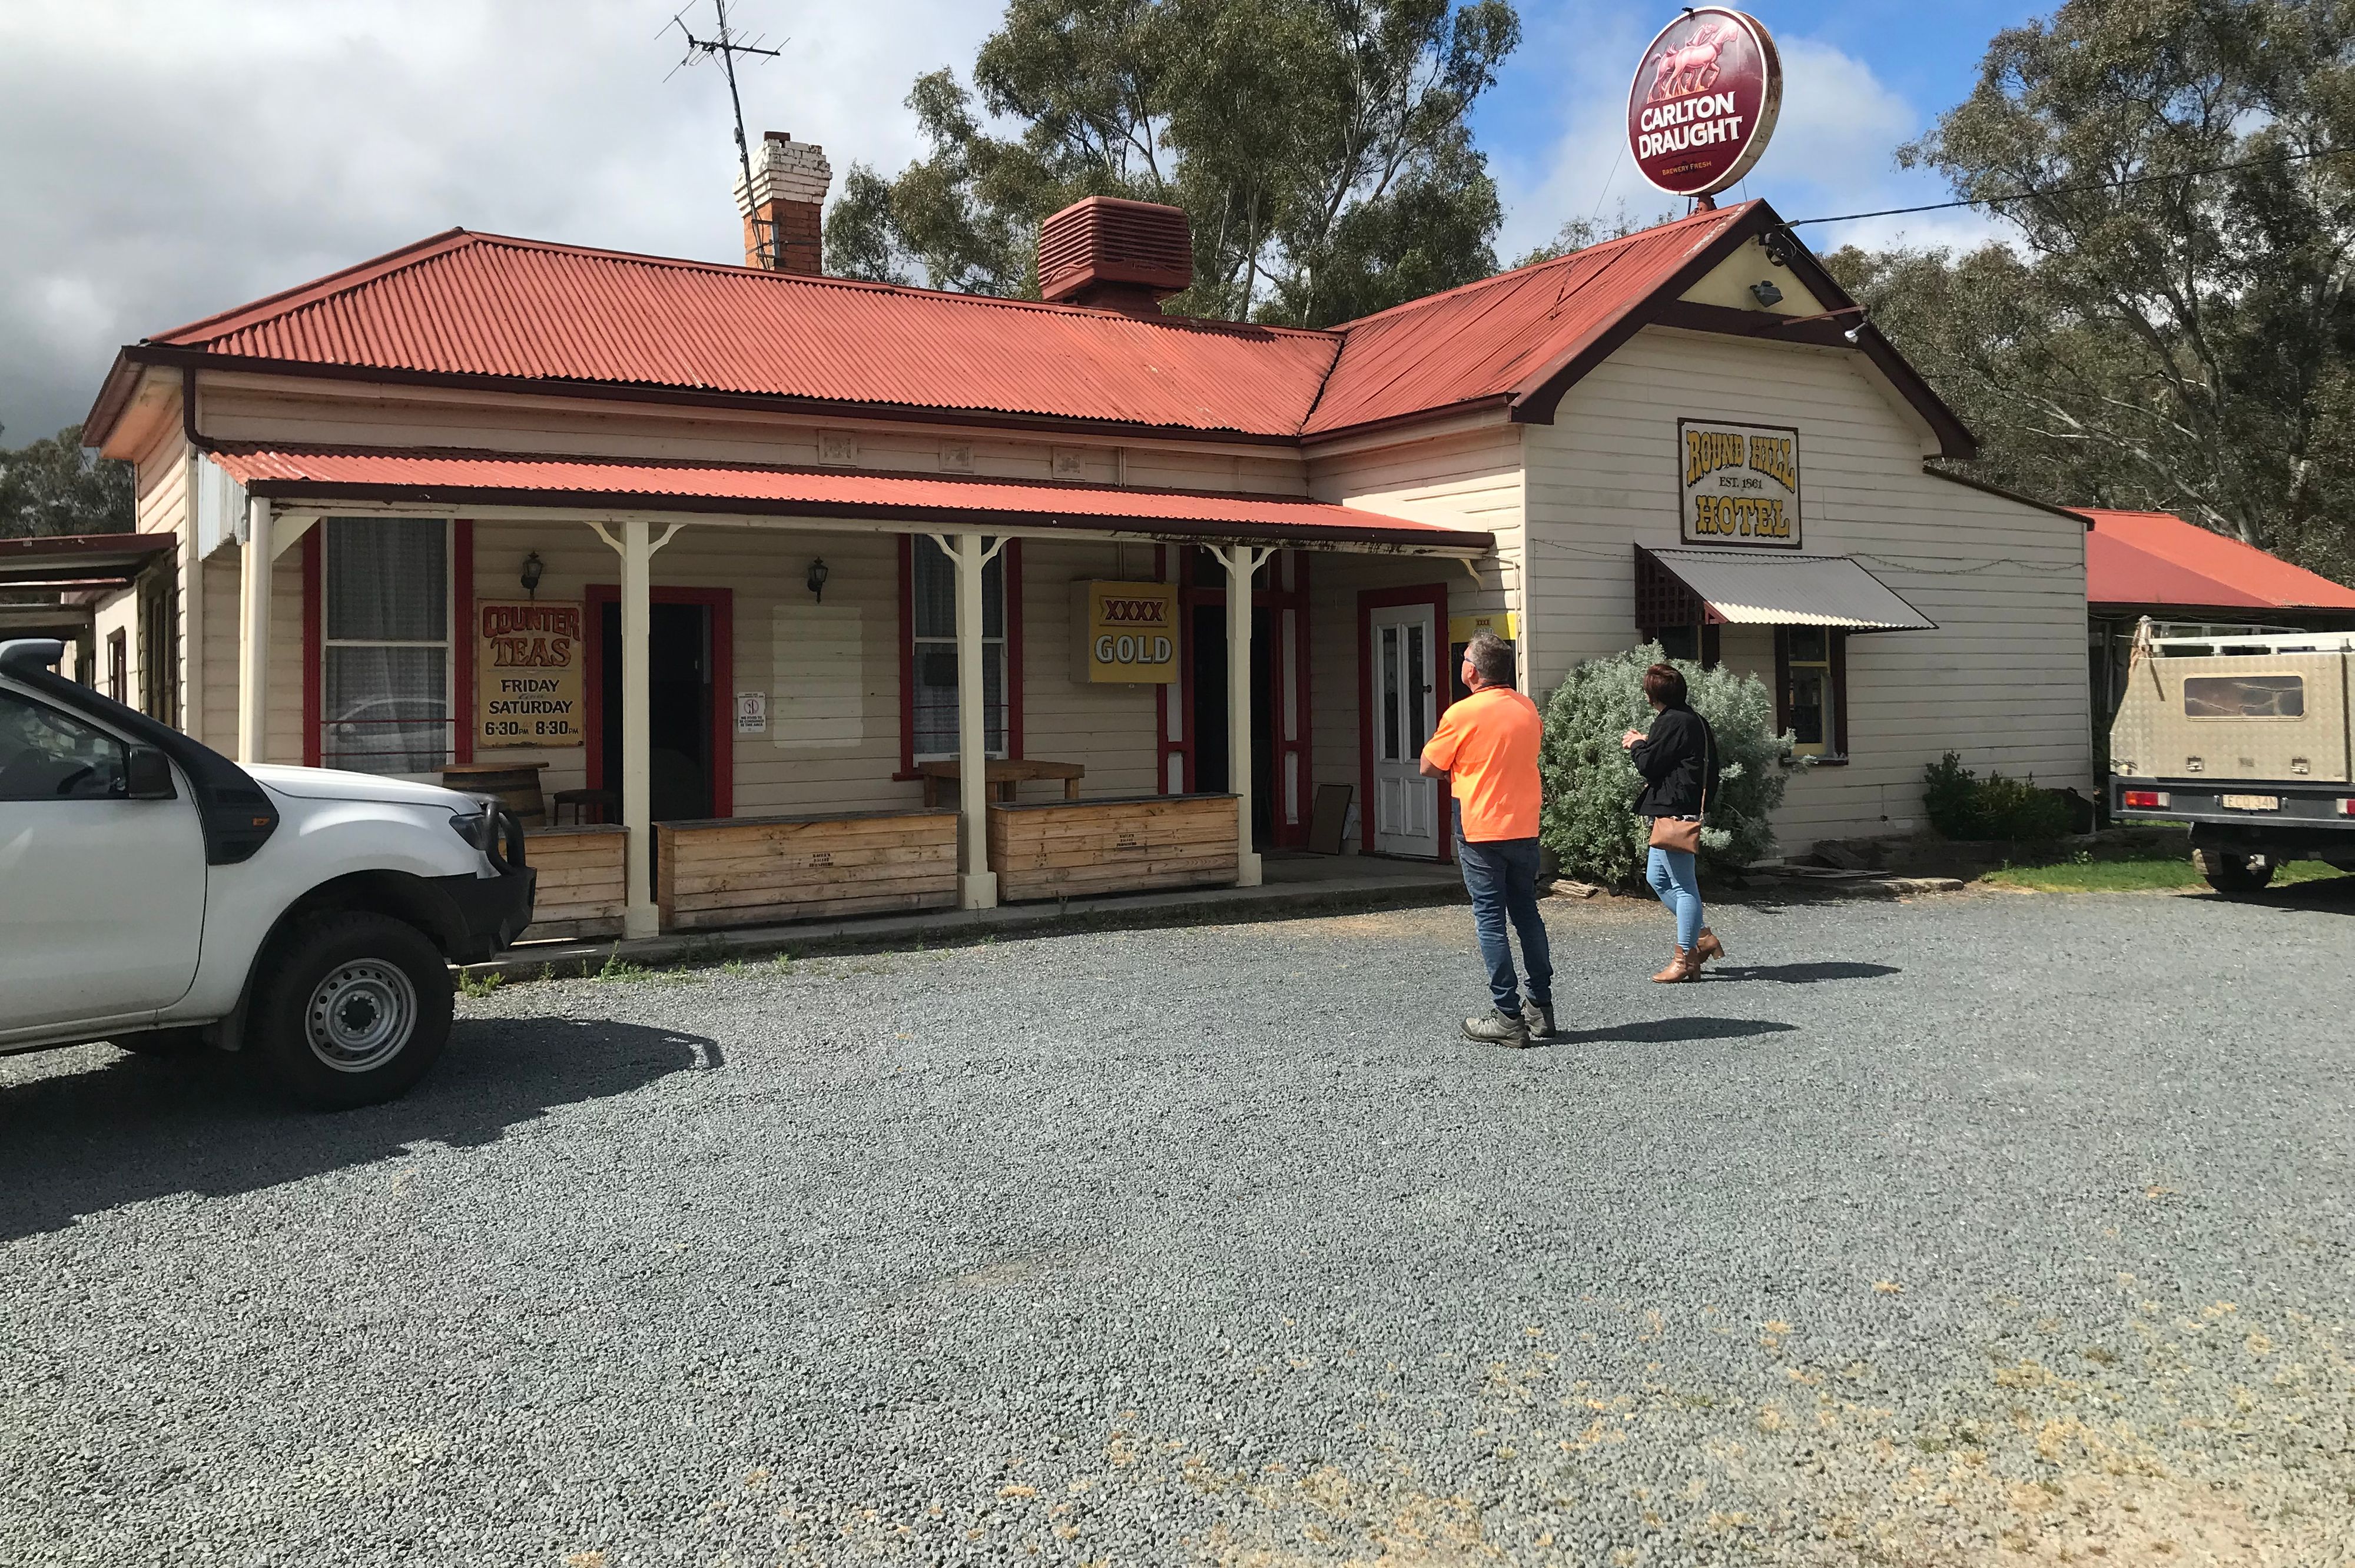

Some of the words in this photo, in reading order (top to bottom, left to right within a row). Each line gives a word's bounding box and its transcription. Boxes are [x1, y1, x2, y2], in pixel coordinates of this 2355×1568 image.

[1641, 91, 1736, 132] CARLTON
[1638, 116, 1743, 160] DRAUGHT
[1662, 165, 1689, 175] BREWERY
[1690, 161, 1711, 170] FRESH
[1686, 430, 1744, 488] ROUND
[1749, 436, 1796, 493] HILL
[1719, 477, 1739, 487] EST.
[1742, 479, 1763, 489] 1861
[1696, 495, 1790, 538] HOTEL
[483, 606, 581, 642] COUNTER
[1105, 600, 1163, 621] XXXX
[490, 637, 572, 667] TEAS
[1094, 634, 1173, 664] GOLD
[500, 679, 560, 693] FRIDAY
[489, 700, 573, 714] SATURDAY
